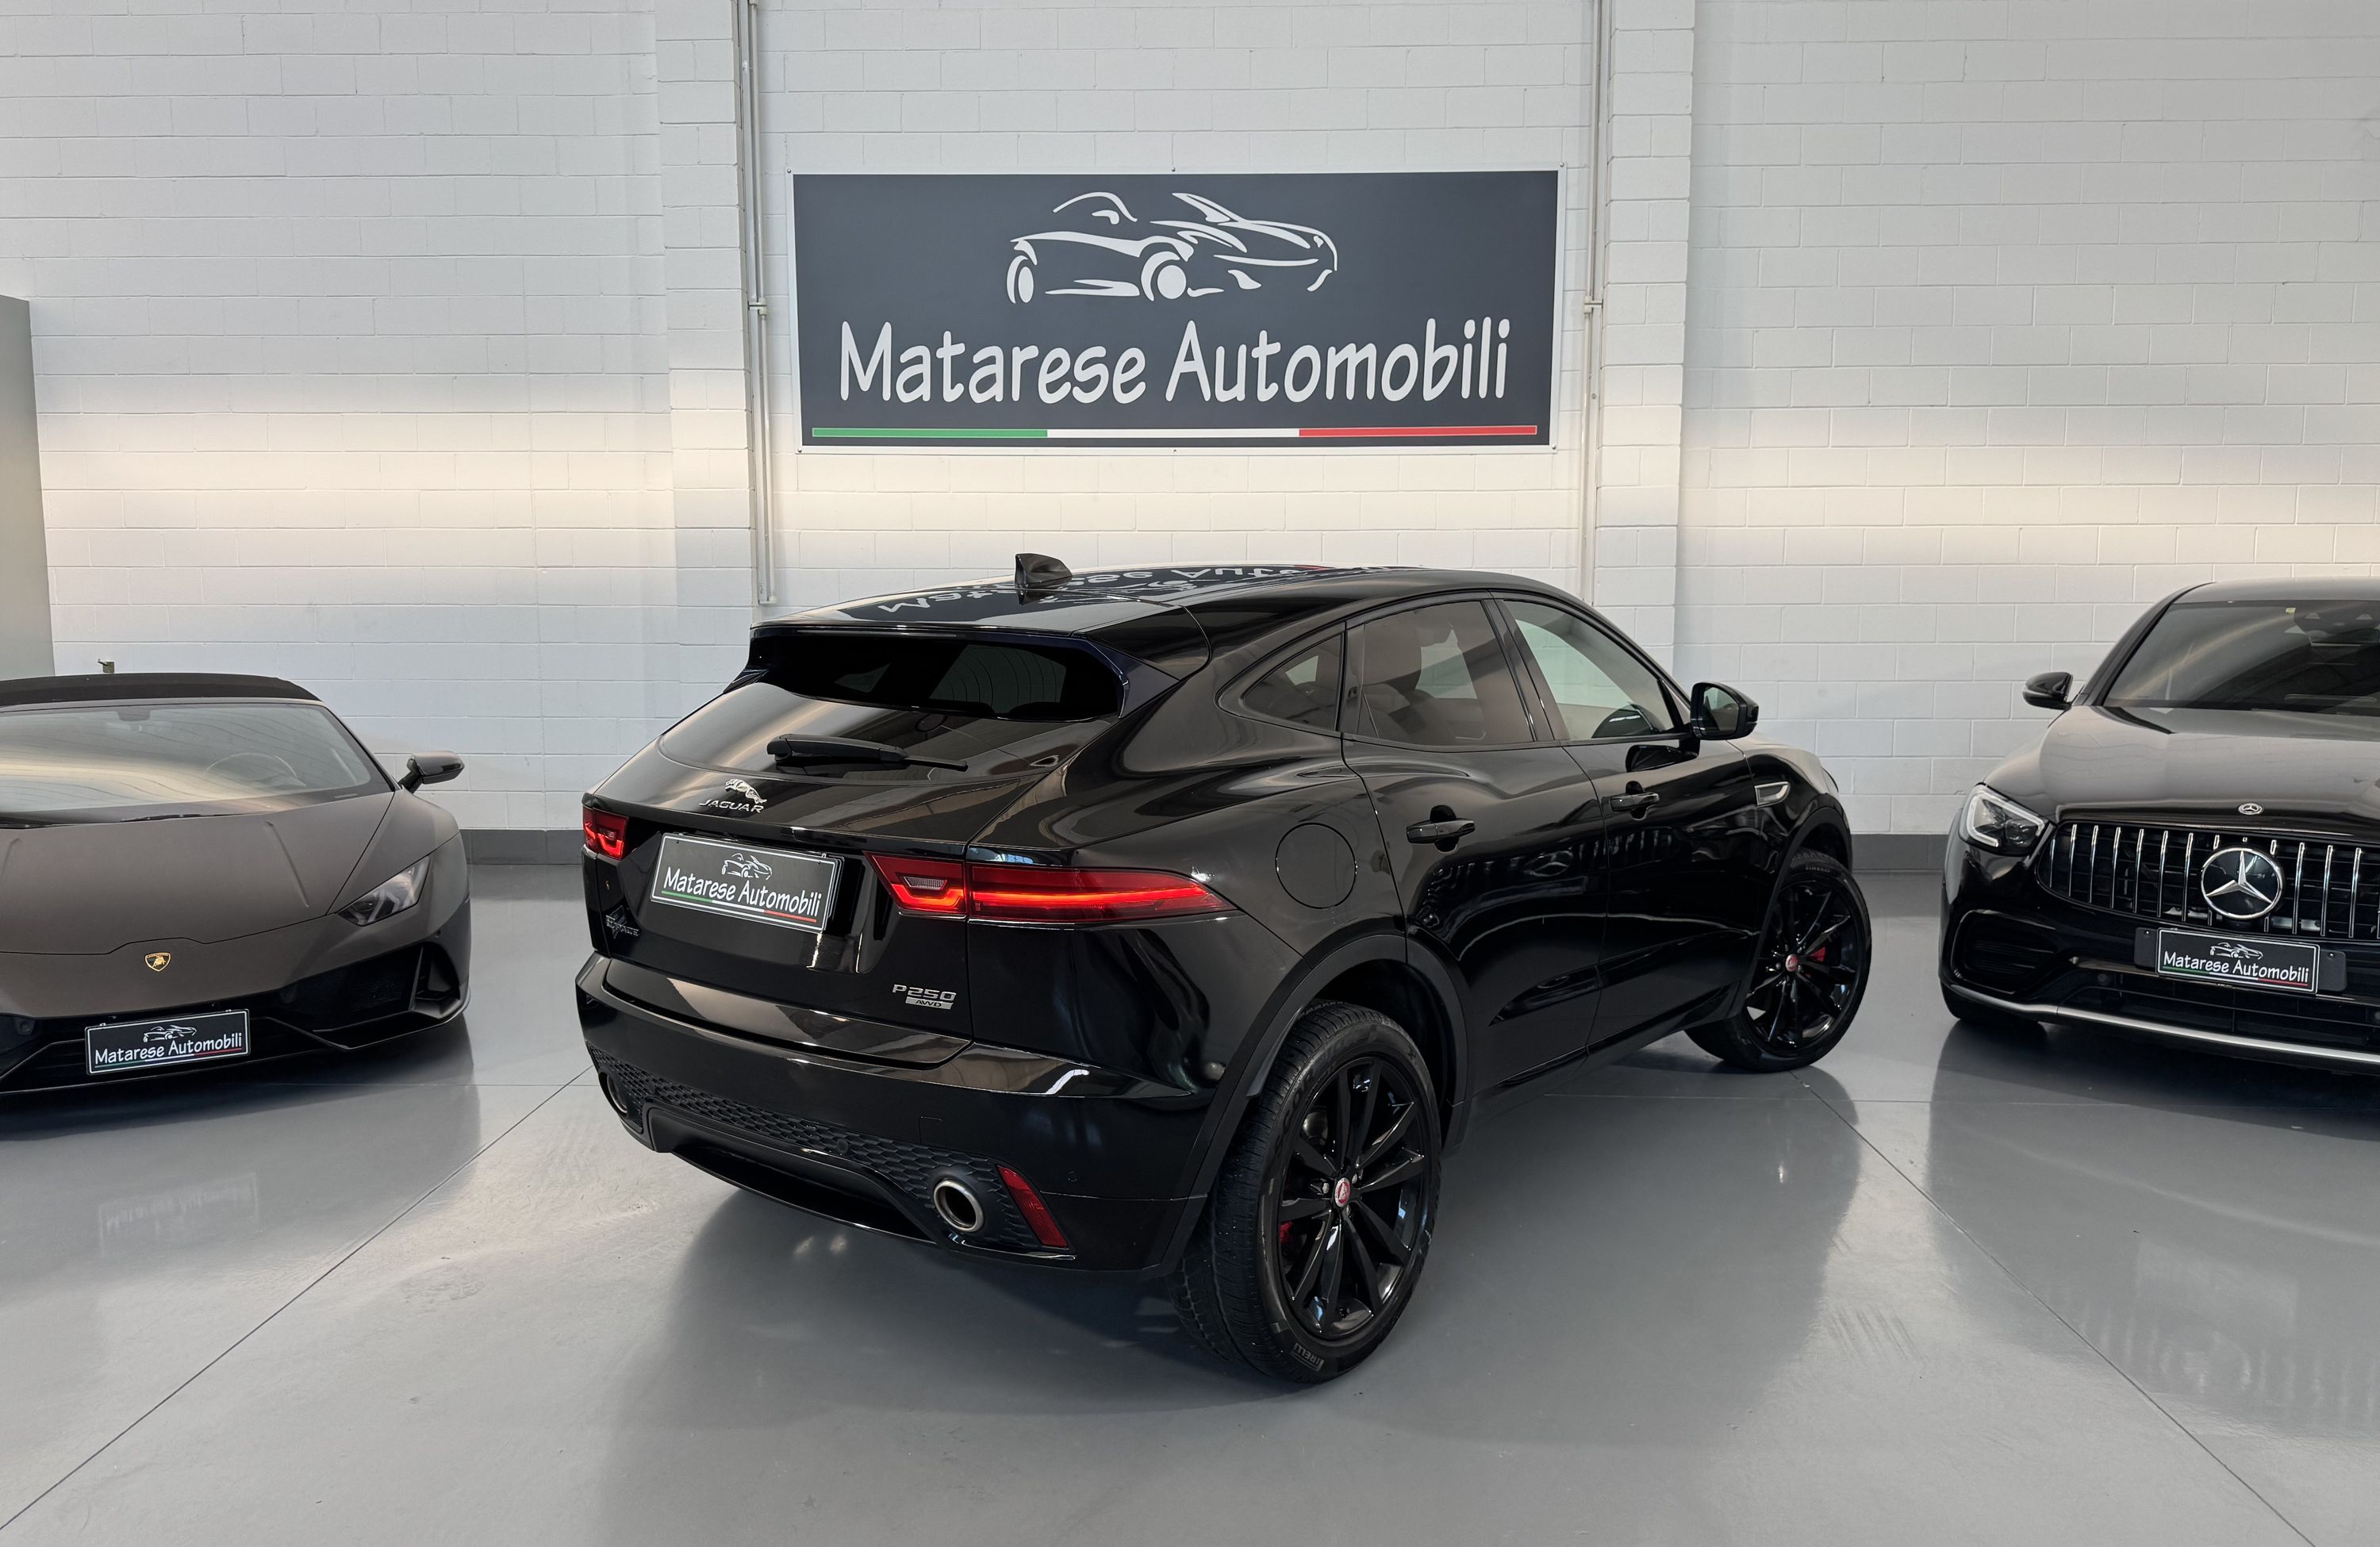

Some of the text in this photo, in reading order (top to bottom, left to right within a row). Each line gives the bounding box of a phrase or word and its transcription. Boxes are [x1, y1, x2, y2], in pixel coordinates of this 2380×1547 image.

[840, 317, 1511, 405] Matarese Automobili
[699, 799, 764, 813] JAGUAR
[663, 866, 822, 917] Matarese Automobili
[2163, 951, 2309, 984] Matarese Automobili
[892, 984, 957, 1001] P250
[916, 999, 942, 1008] AWD
[94, 1032, 243, 1065] Matarese Automobili
[1293, 1342, 1324, 1371] PIRELLI
